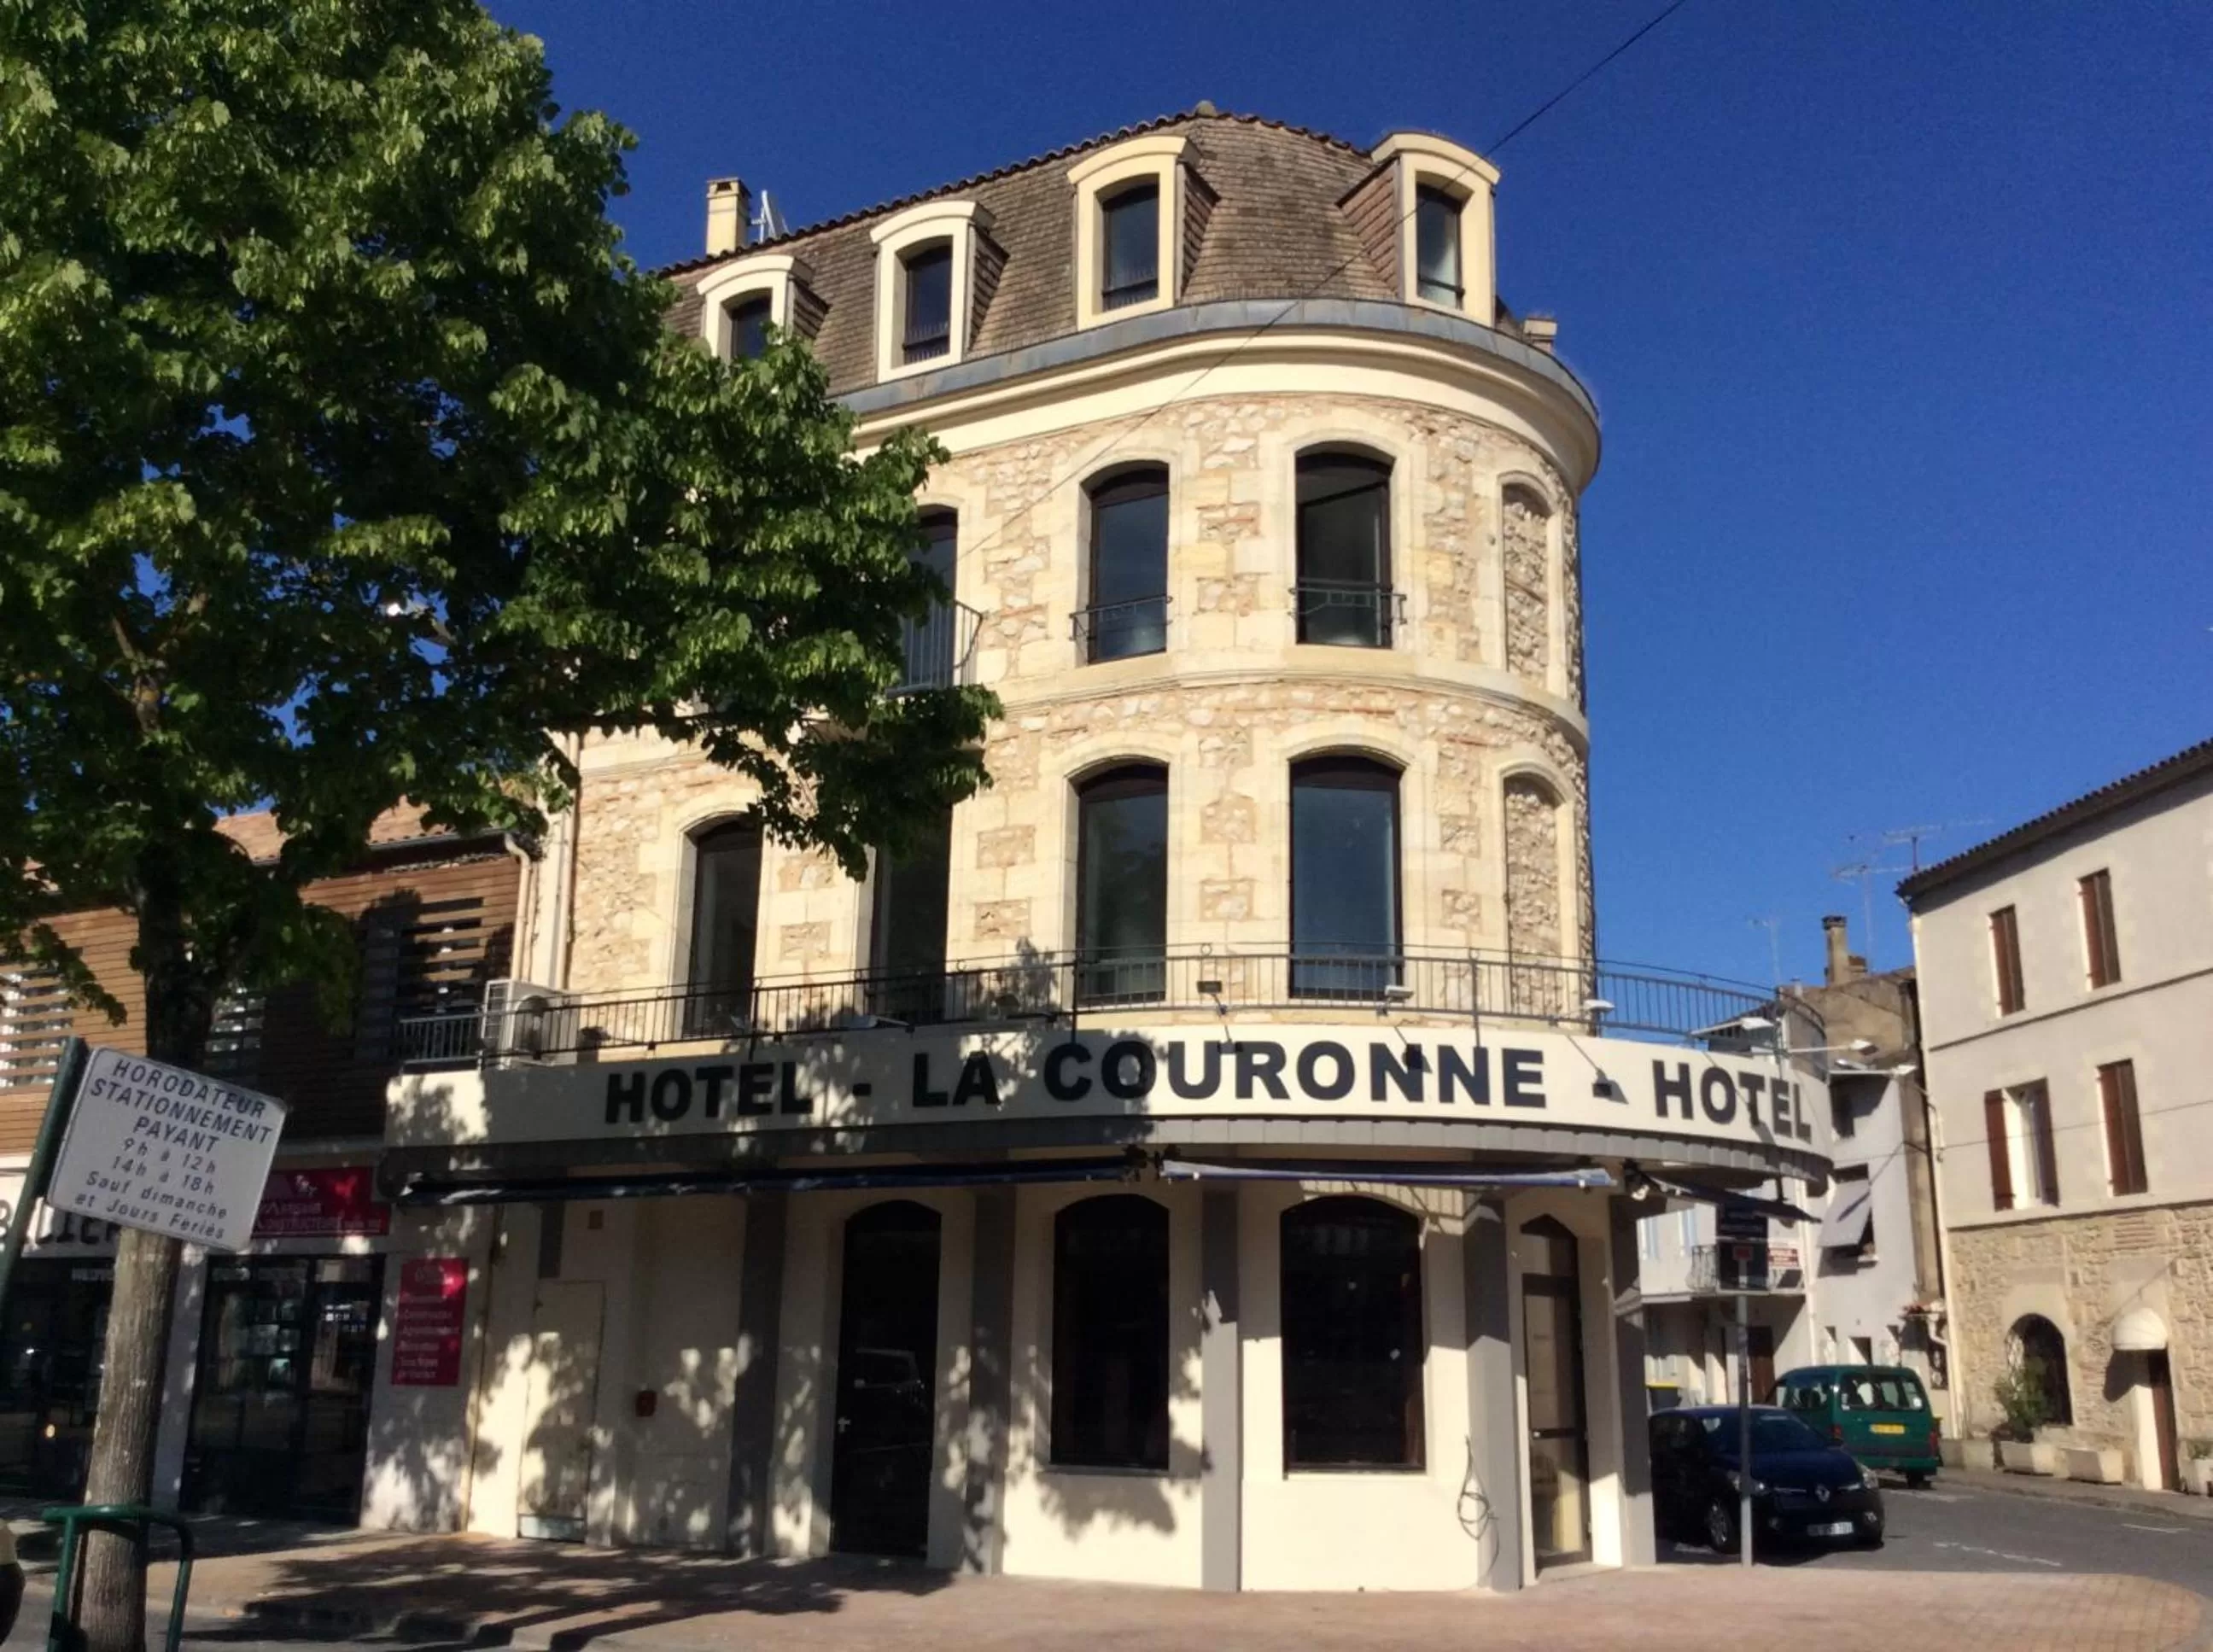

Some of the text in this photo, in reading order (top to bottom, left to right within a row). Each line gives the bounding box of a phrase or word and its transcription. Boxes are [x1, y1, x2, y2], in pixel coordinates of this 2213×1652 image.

[91, 1077, 272, 1145] STATIONNEMENT
[112, 1059, 266, 1119] HORODATEUR
[604, 1062, 813, 1124] HOTEL
[913, 1051, 999, 1107] LA
[1043, 1040, 1546, 1107] COURONNE
[1652, 1059, 1812, 1144] HOTEL
[132, 1116, 220, 1153] PAYANT
[86, 1170, 132, 1194] Sauf
[141, 1186, 228, 1220] dimanche
